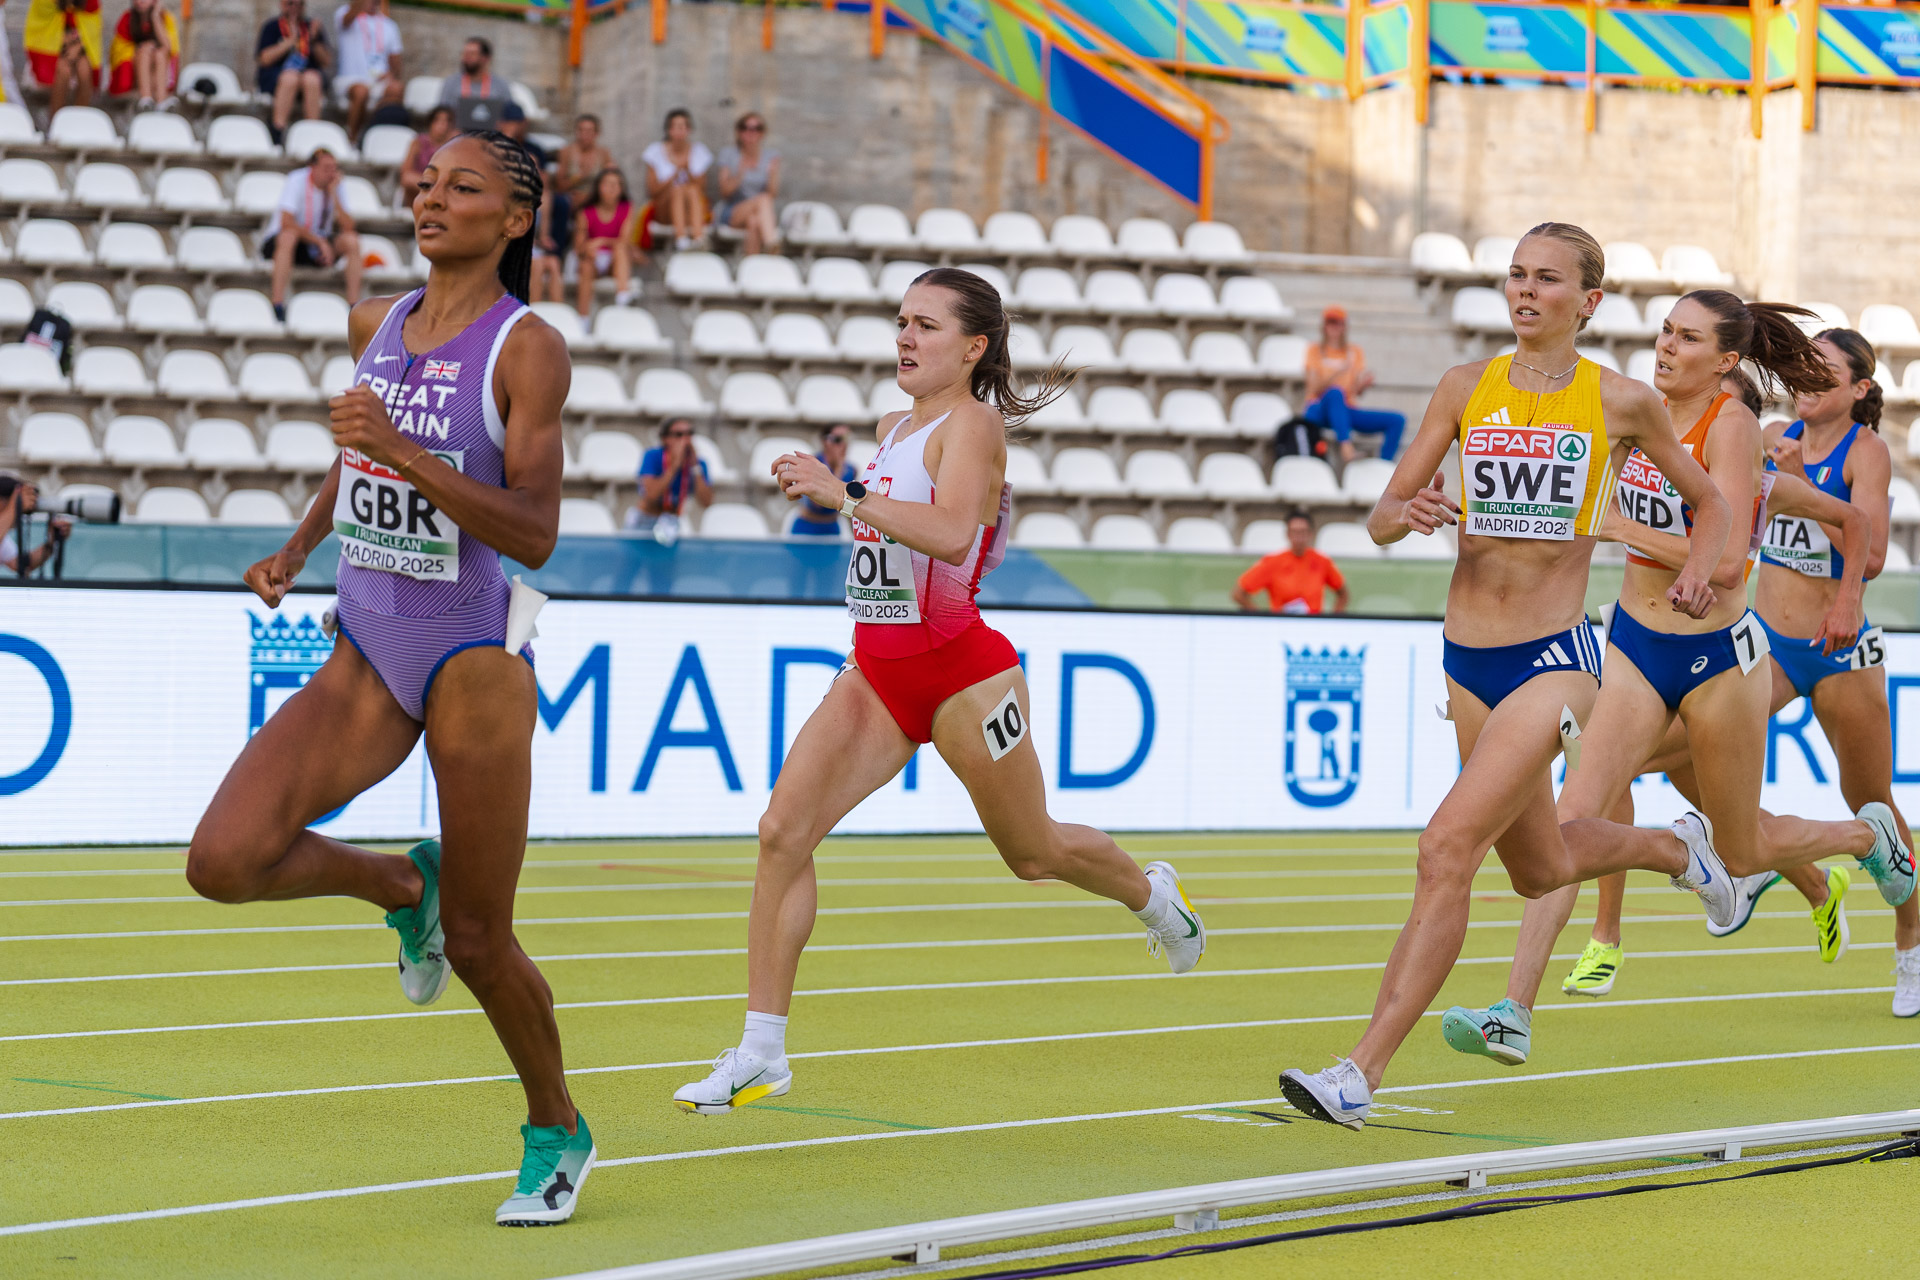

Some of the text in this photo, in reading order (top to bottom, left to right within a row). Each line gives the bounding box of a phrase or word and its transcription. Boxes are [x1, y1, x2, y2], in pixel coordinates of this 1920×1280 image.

[1467, 432, 1553, 455] SPAR
[1474, 460, 1575, 504] SWE
[1621, 461, 1662, 490] SPAR
[350, 477, 442, 537] GBR
[1484, 503, 1488, 512] I
[1489, 503, 1513, 514] RUN
[1620, 486, 1674, 529] NED
[355, 526, 360, 538] I
[359, 528, 380, 544] RUN
[852, 519, 881, 540] PAR
[1474, 517, 1569, 536] MADRID 2025
[1770, 516, 1812, 550] ITA
[341, 541, 445, 573] MADRID 2025
[875, 604, 909, 619] 2025
[1735, 624, 1756, 663] 7
[1857, 636, 1884, 668] 15
[986, 701, 1022, 751] 10
